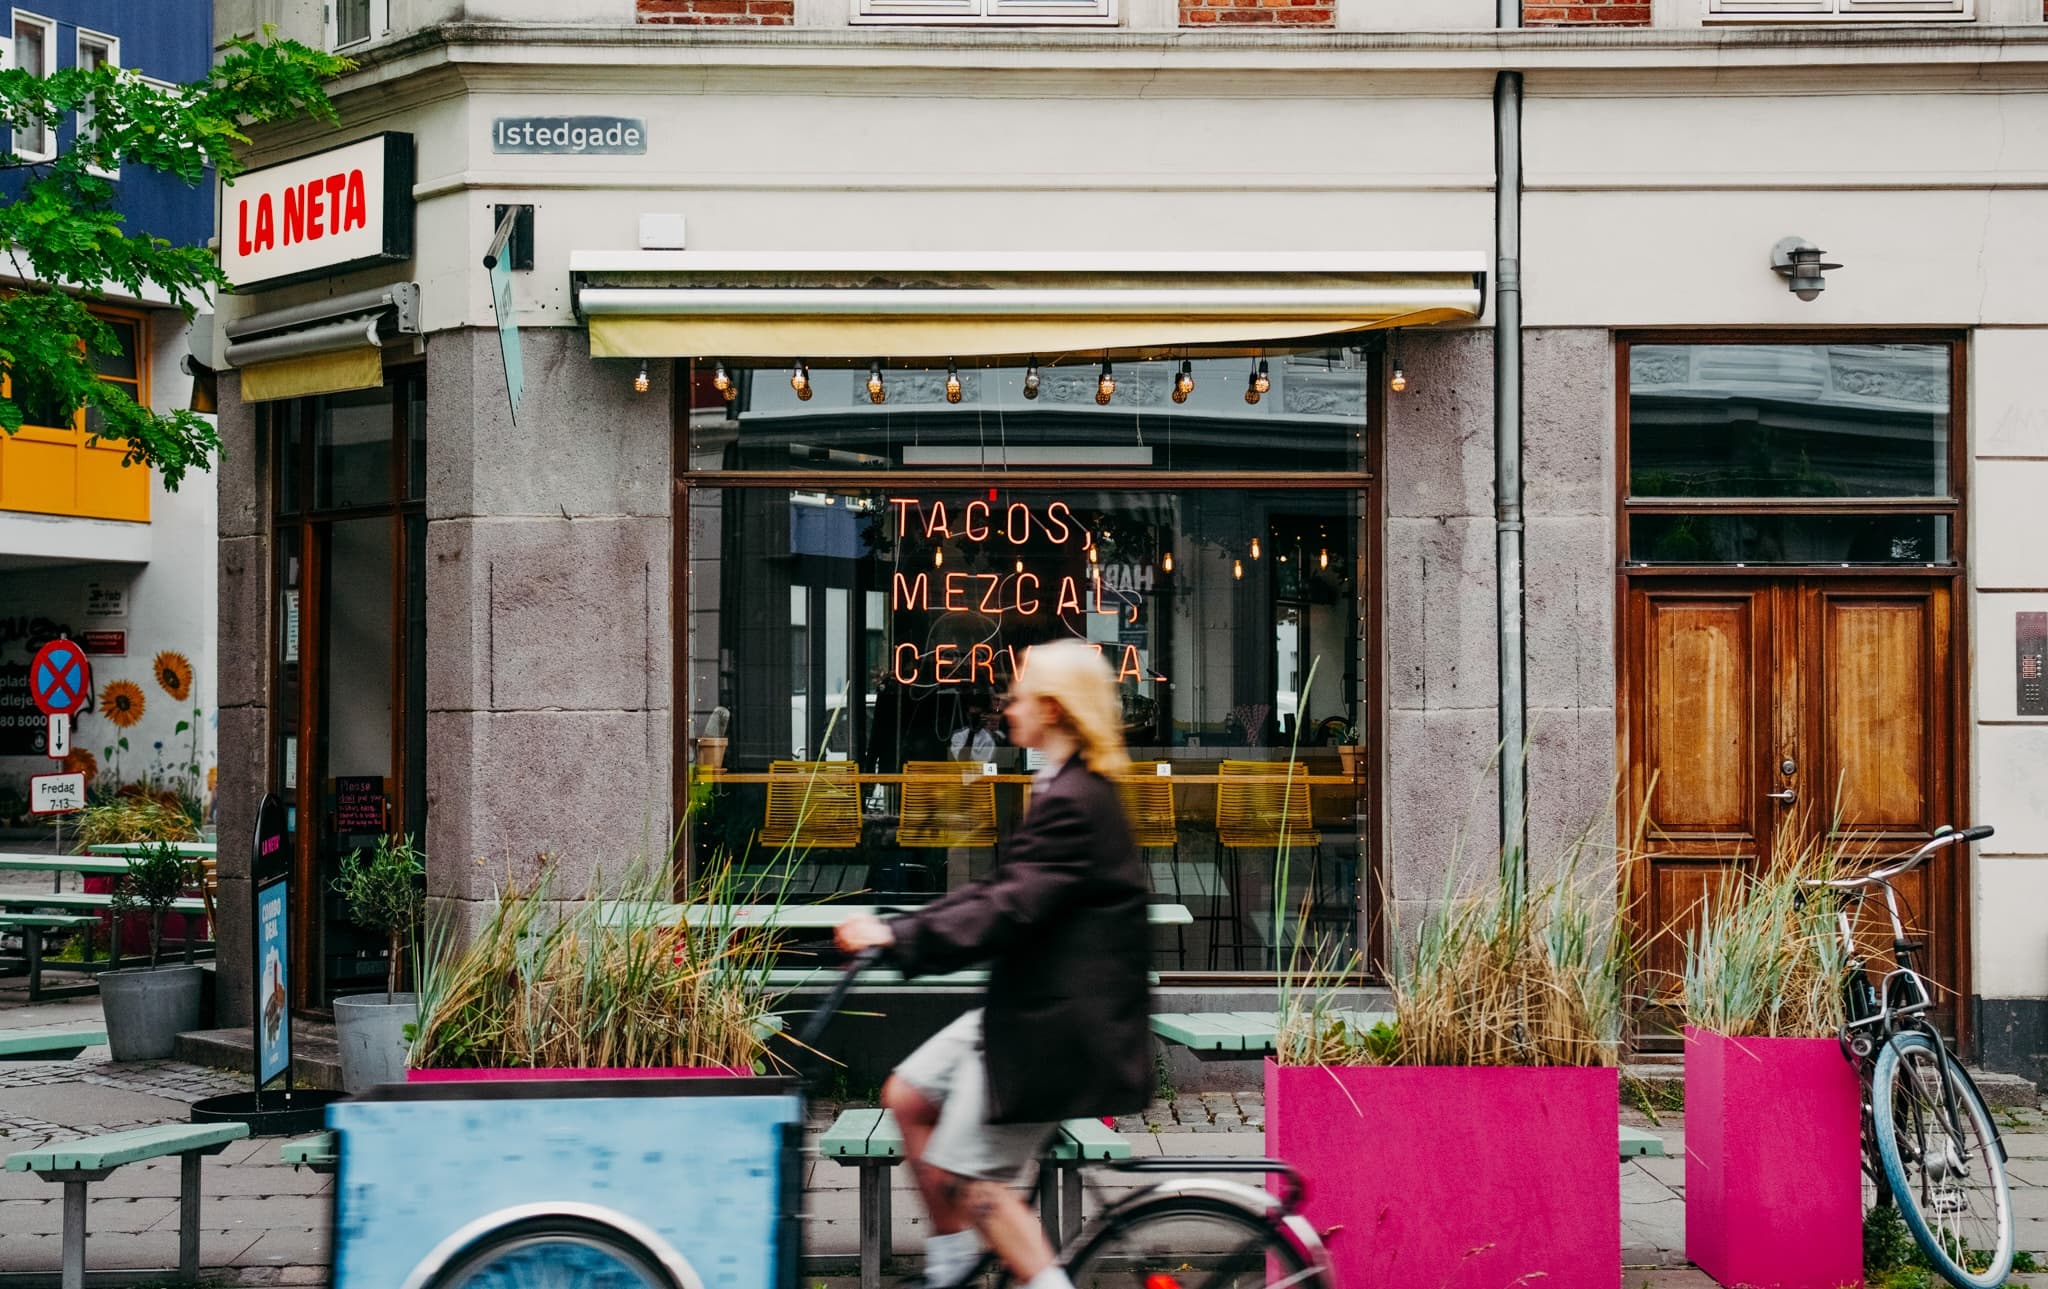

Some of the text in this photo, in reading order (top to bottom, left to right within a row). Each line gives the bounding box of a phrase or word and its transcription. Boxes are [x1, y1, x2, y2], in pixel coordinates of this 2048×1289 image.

[498, 121, 640, 151] Istedgade
[238, 168, 367, 257] LA NETA
[889, 497, 1092, 551] TACOS,
[893, 572, 1139, 623] MEZCAL,
[17, 715, 48, 727] 8000
[41, 782, 75, 795] Fredag
[50, 798, 70, 810] 7-13
